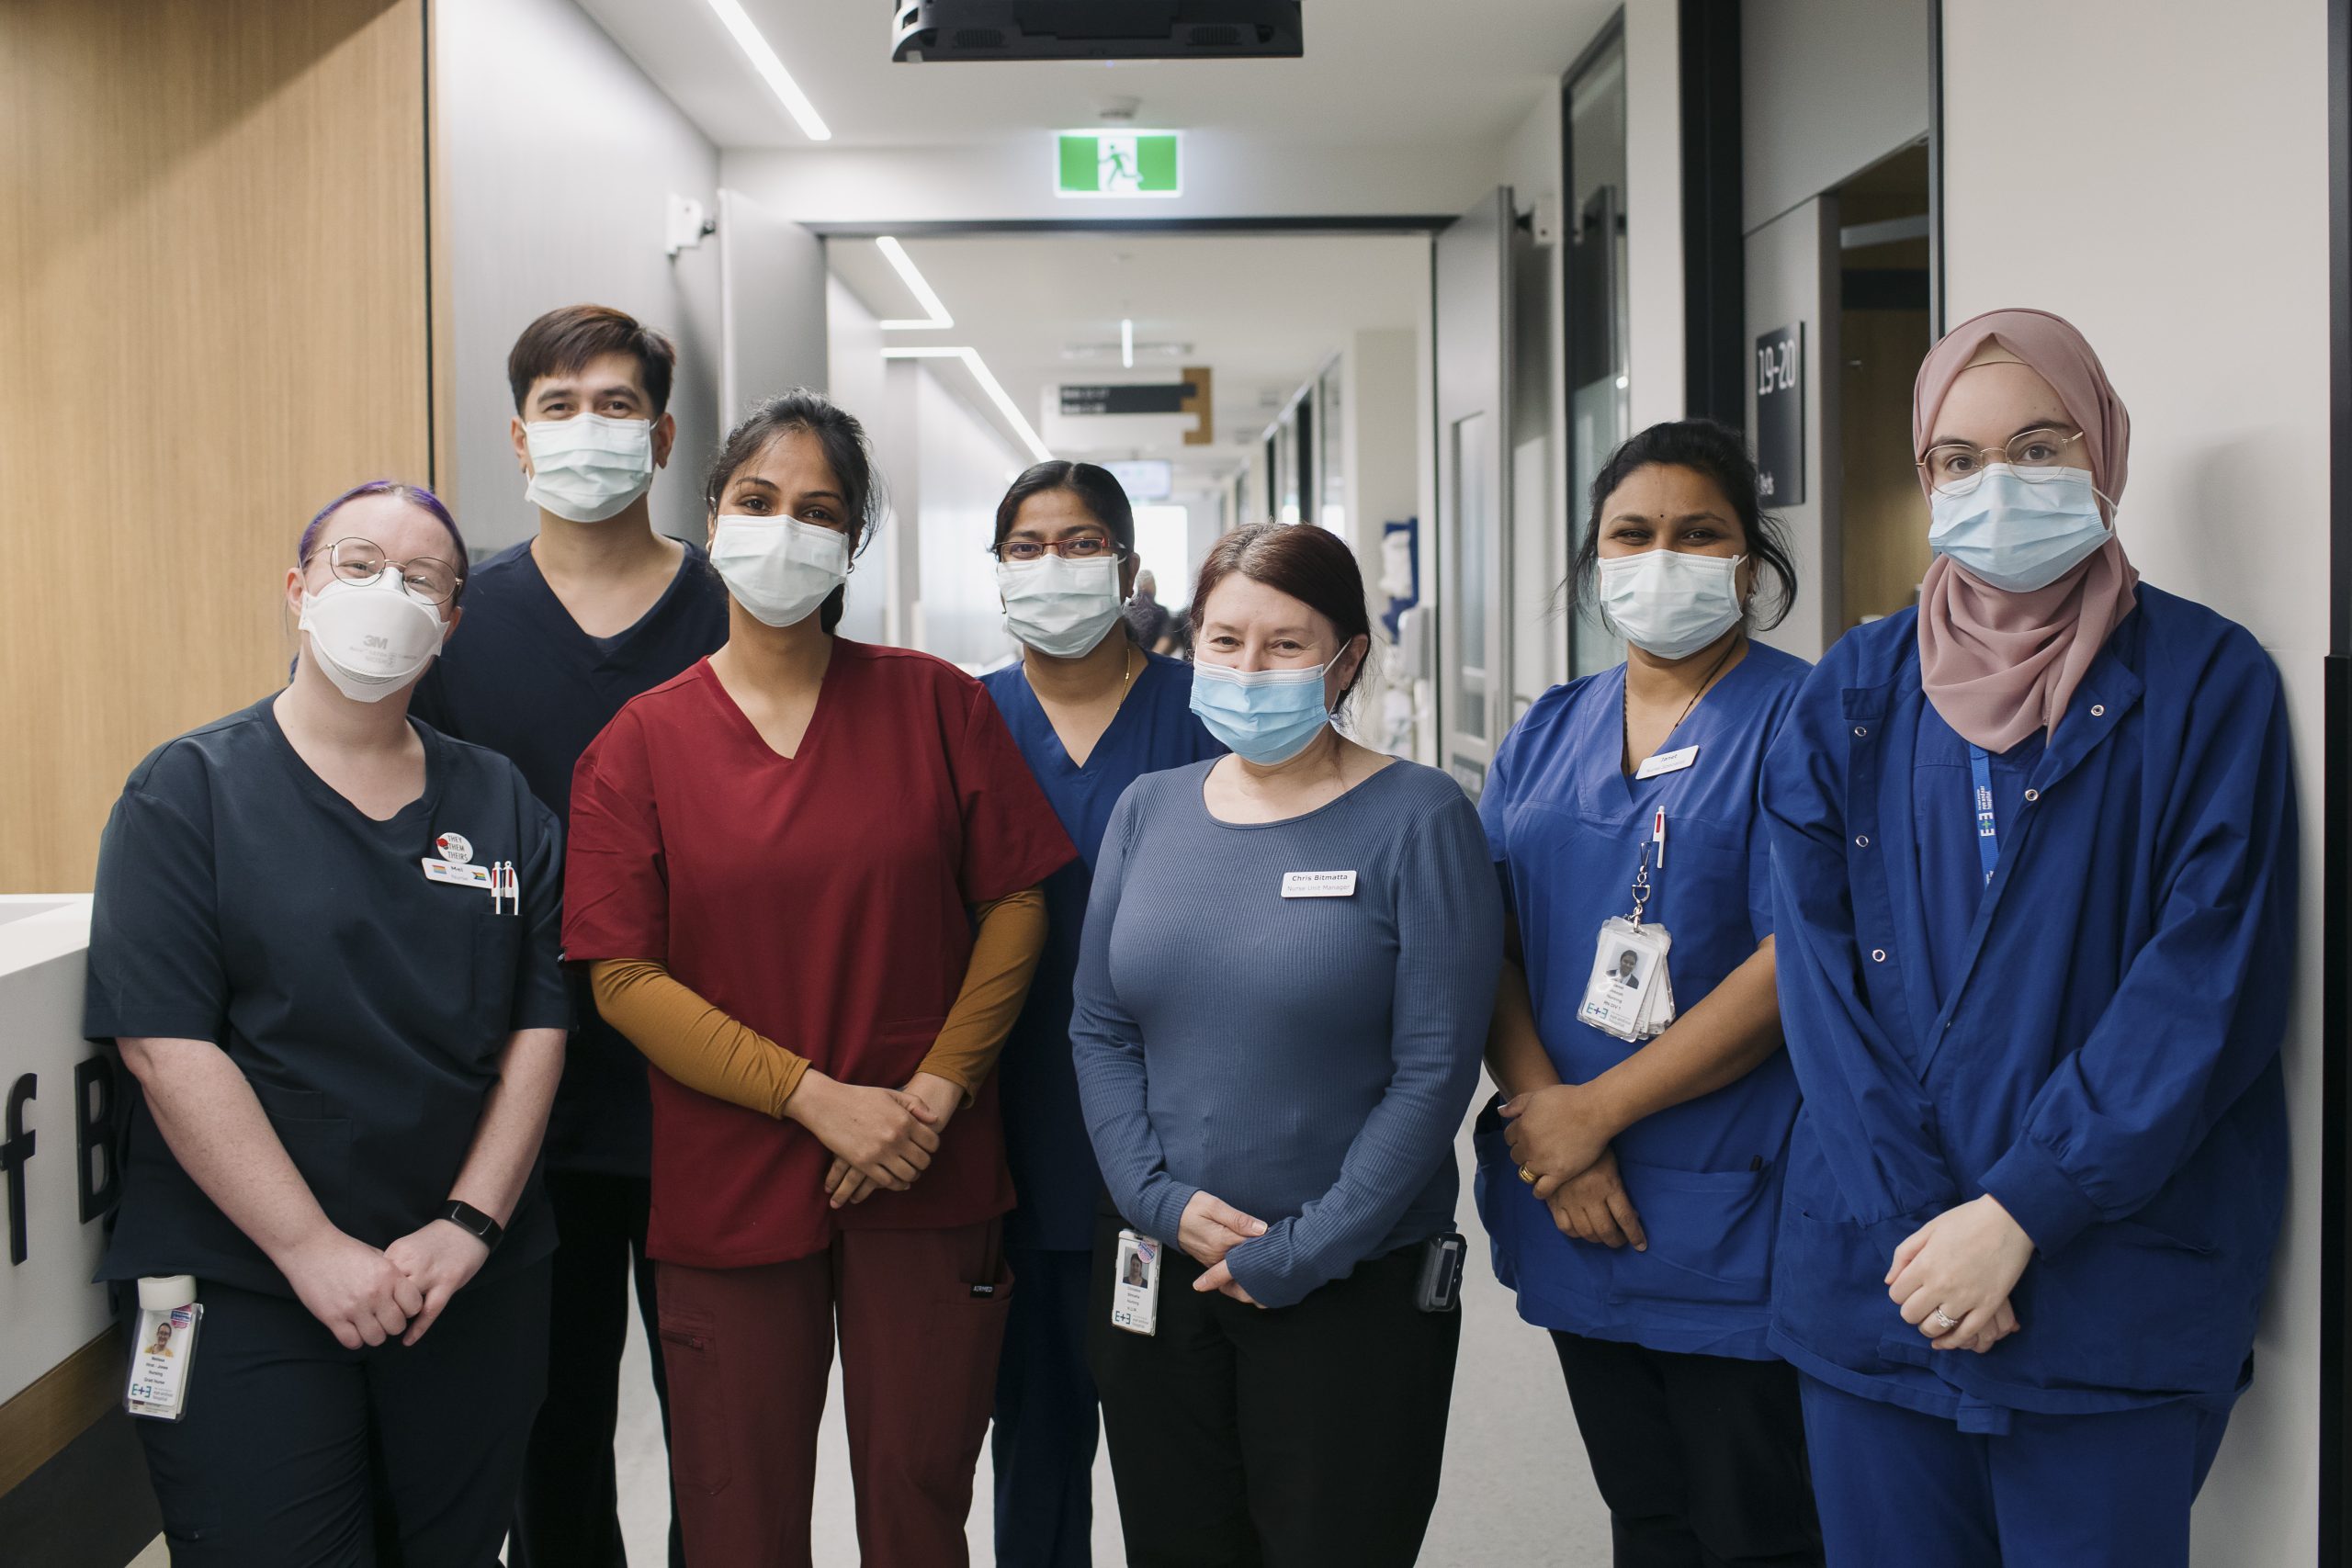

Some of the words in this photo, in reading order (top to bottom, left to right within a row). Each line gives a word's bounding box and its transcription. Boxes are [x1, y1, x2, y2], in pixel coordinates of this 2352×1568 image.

[1758, 339, 1796, 395] 19-20
[363, 635, 389, 649] 3M
[447, 835, 462, 844] THEY
[447, 843, 465, 852] THEM
[447, 852, 469, 862] THEIRS
